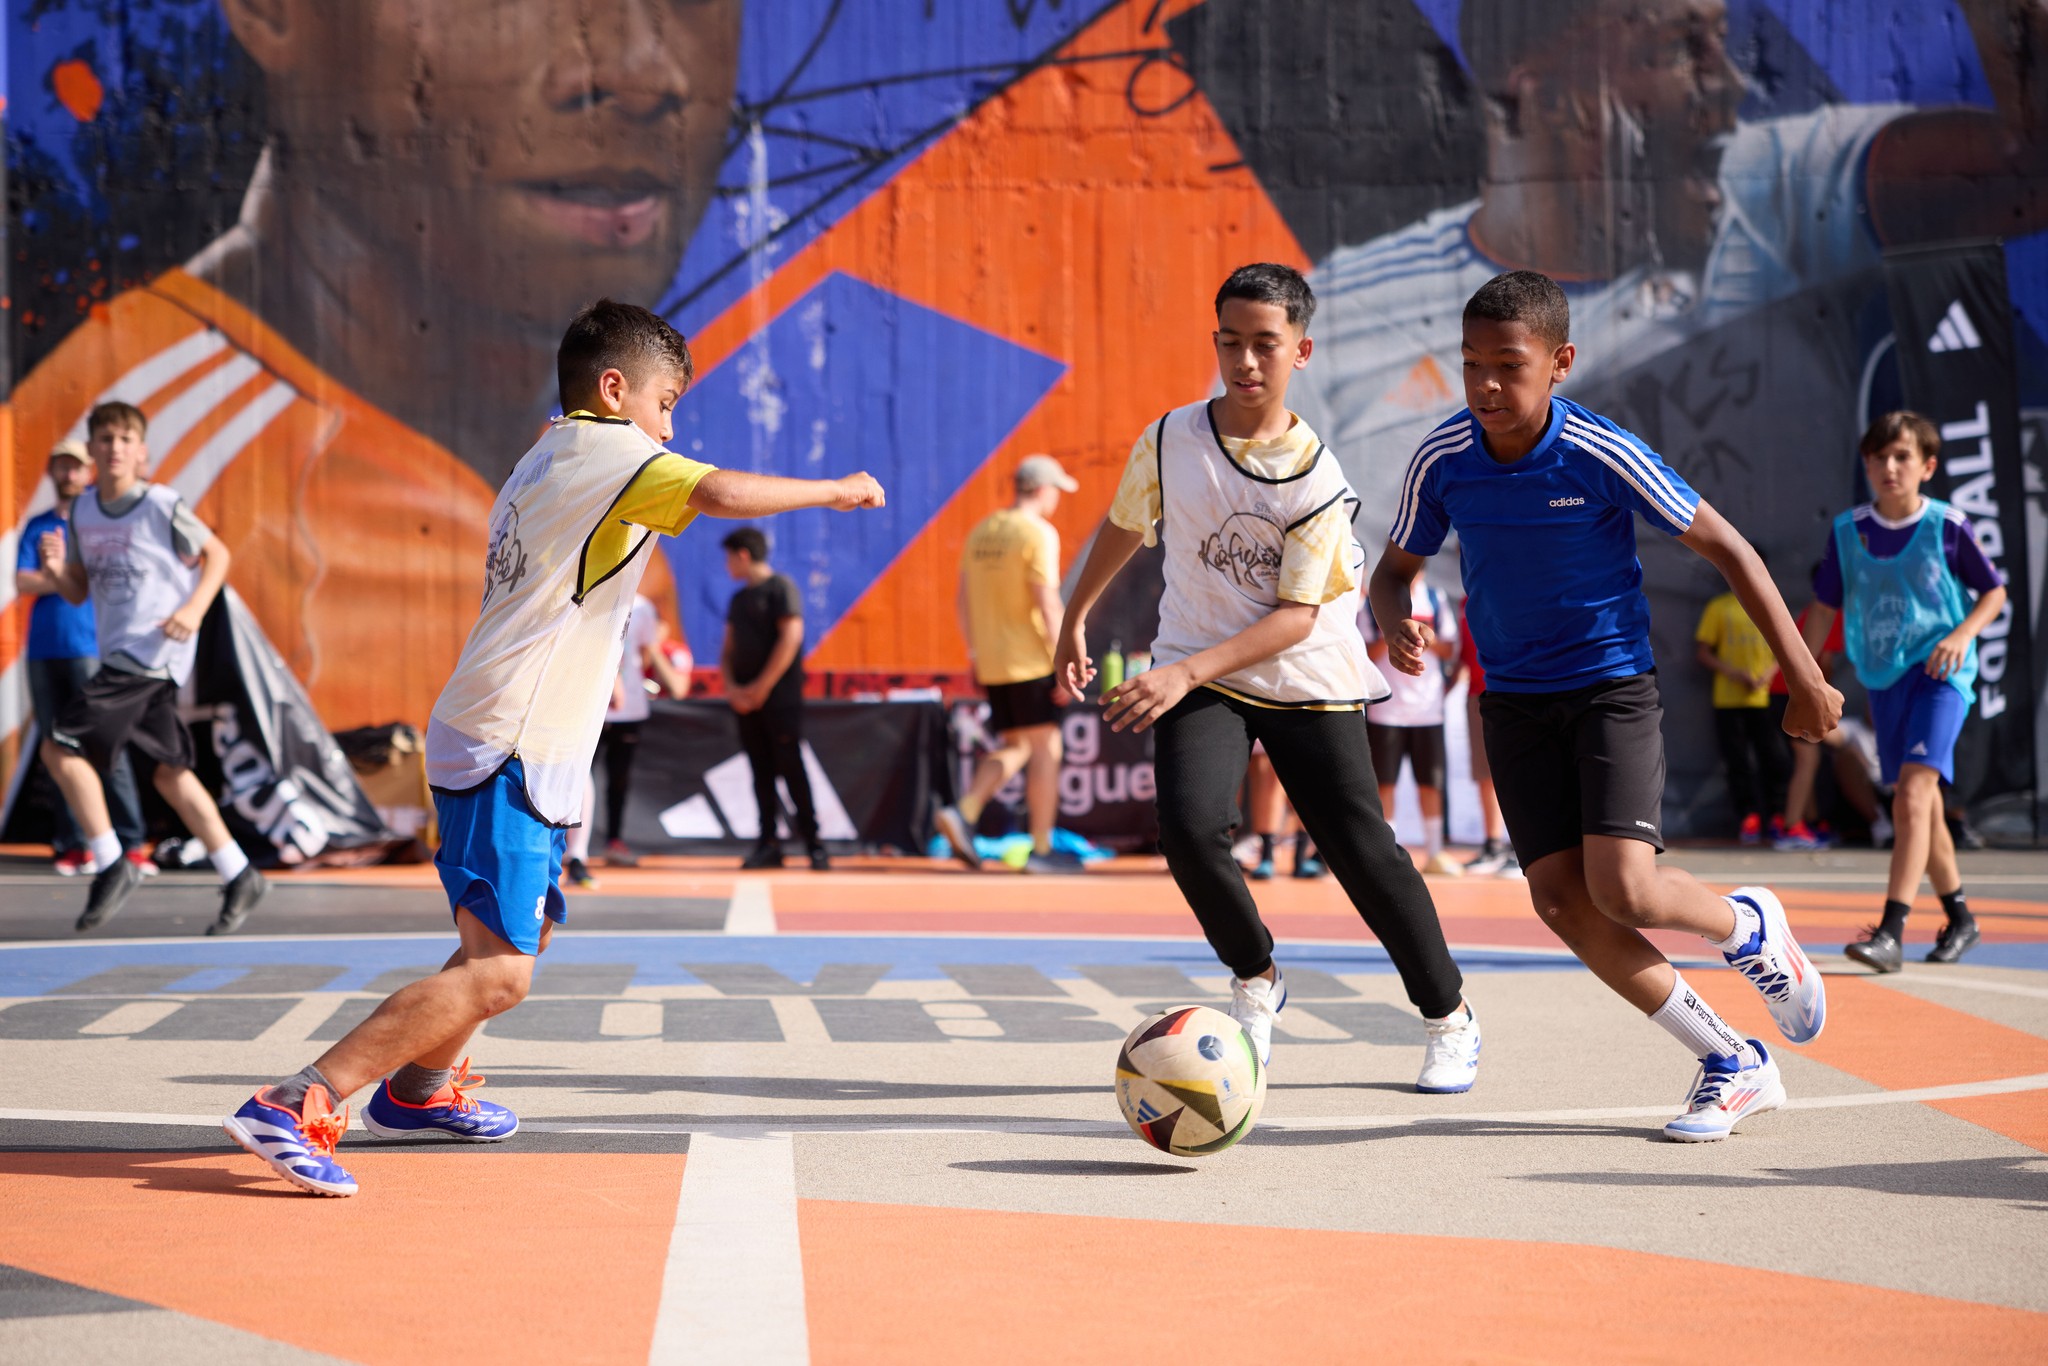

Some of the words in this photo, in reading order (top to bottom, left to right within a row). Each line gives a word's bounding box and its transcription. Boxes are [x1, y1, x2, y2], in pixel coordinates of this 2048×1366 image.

[1549, 496, 1585, 507] adidas
[1941, 401, 2013, 719] FOOBALL
[534, 895, 546, 920] 8
[1695, 1004, 1745, 1053] FOOTBALLSOCKS
